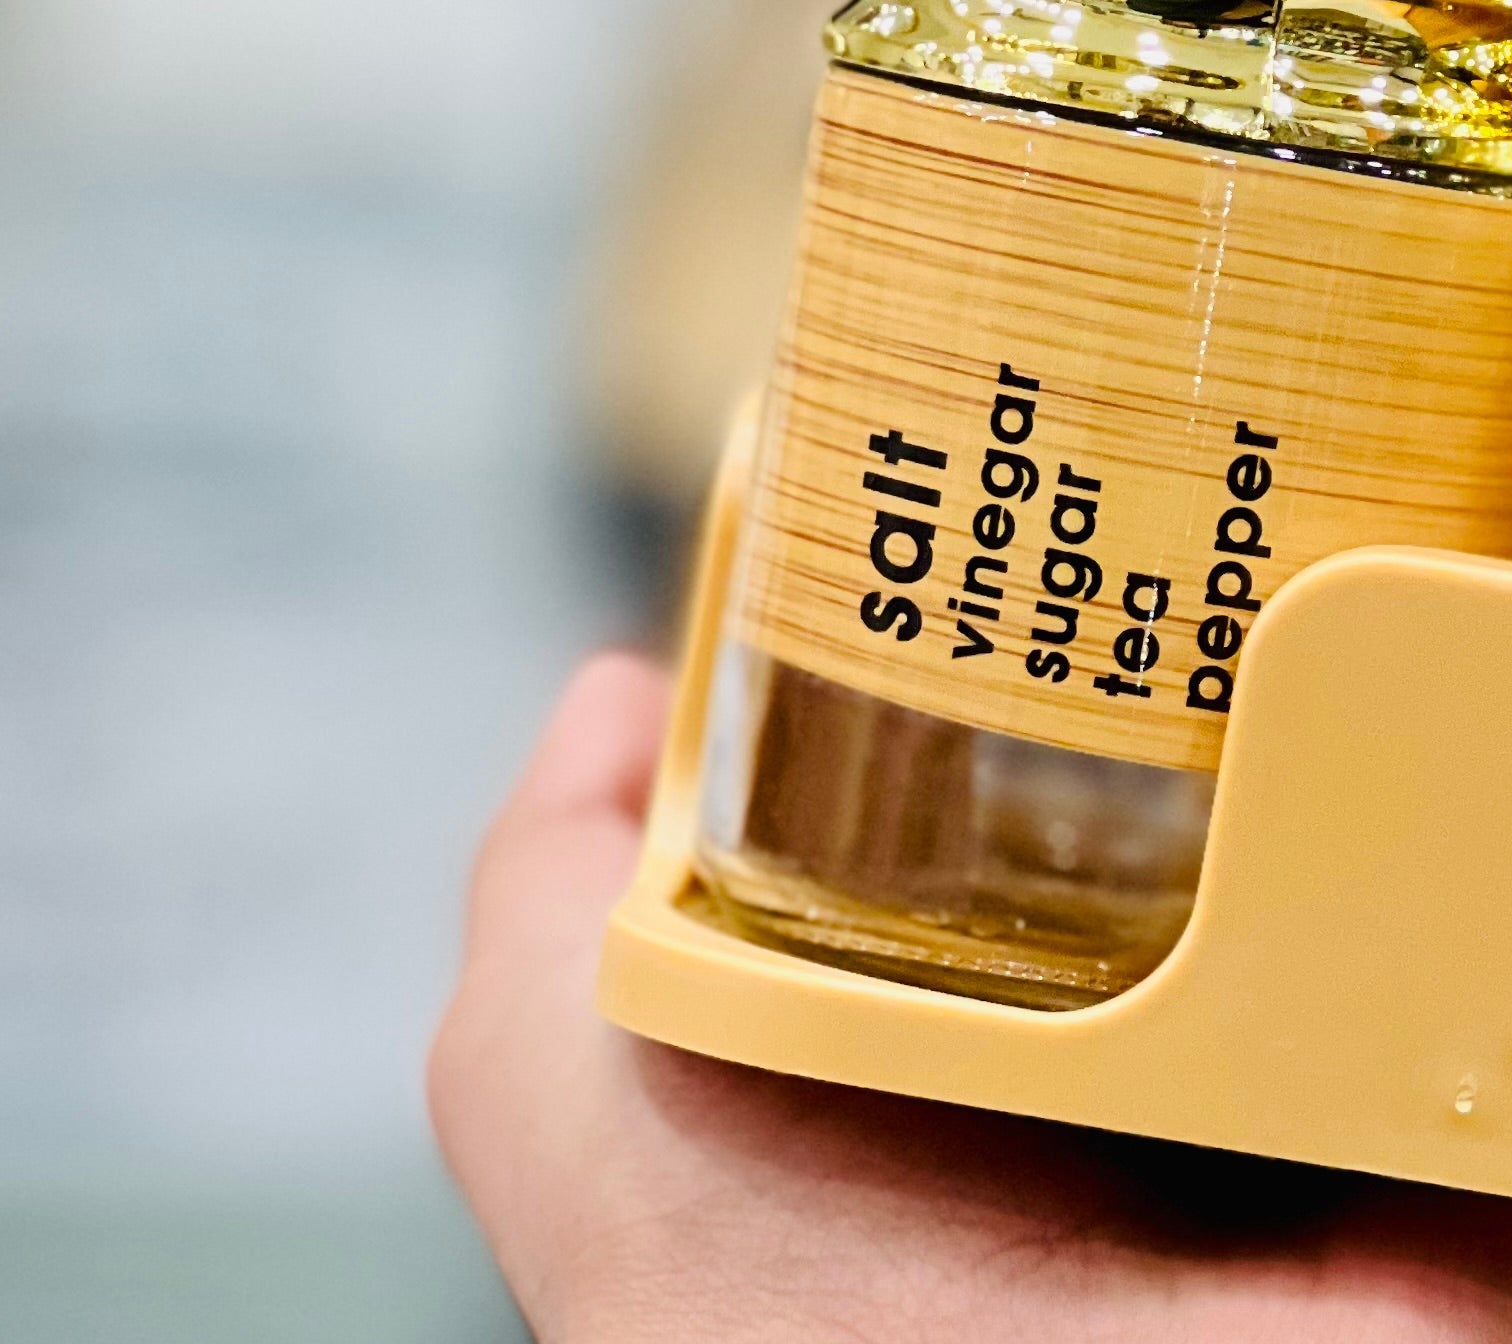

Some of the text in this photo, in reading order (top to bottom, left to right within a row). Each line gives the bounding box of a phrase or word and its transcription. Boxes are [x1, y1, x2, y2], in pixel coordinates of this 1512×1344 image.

[860, 429, 947, 641] salt
[948, 363, 1040, 659] vinegar
[1026, 463, 1102, 683] sugar
[1186, 421, 1278, 713] pepper
[1093, 572, 1171, 698] tea
